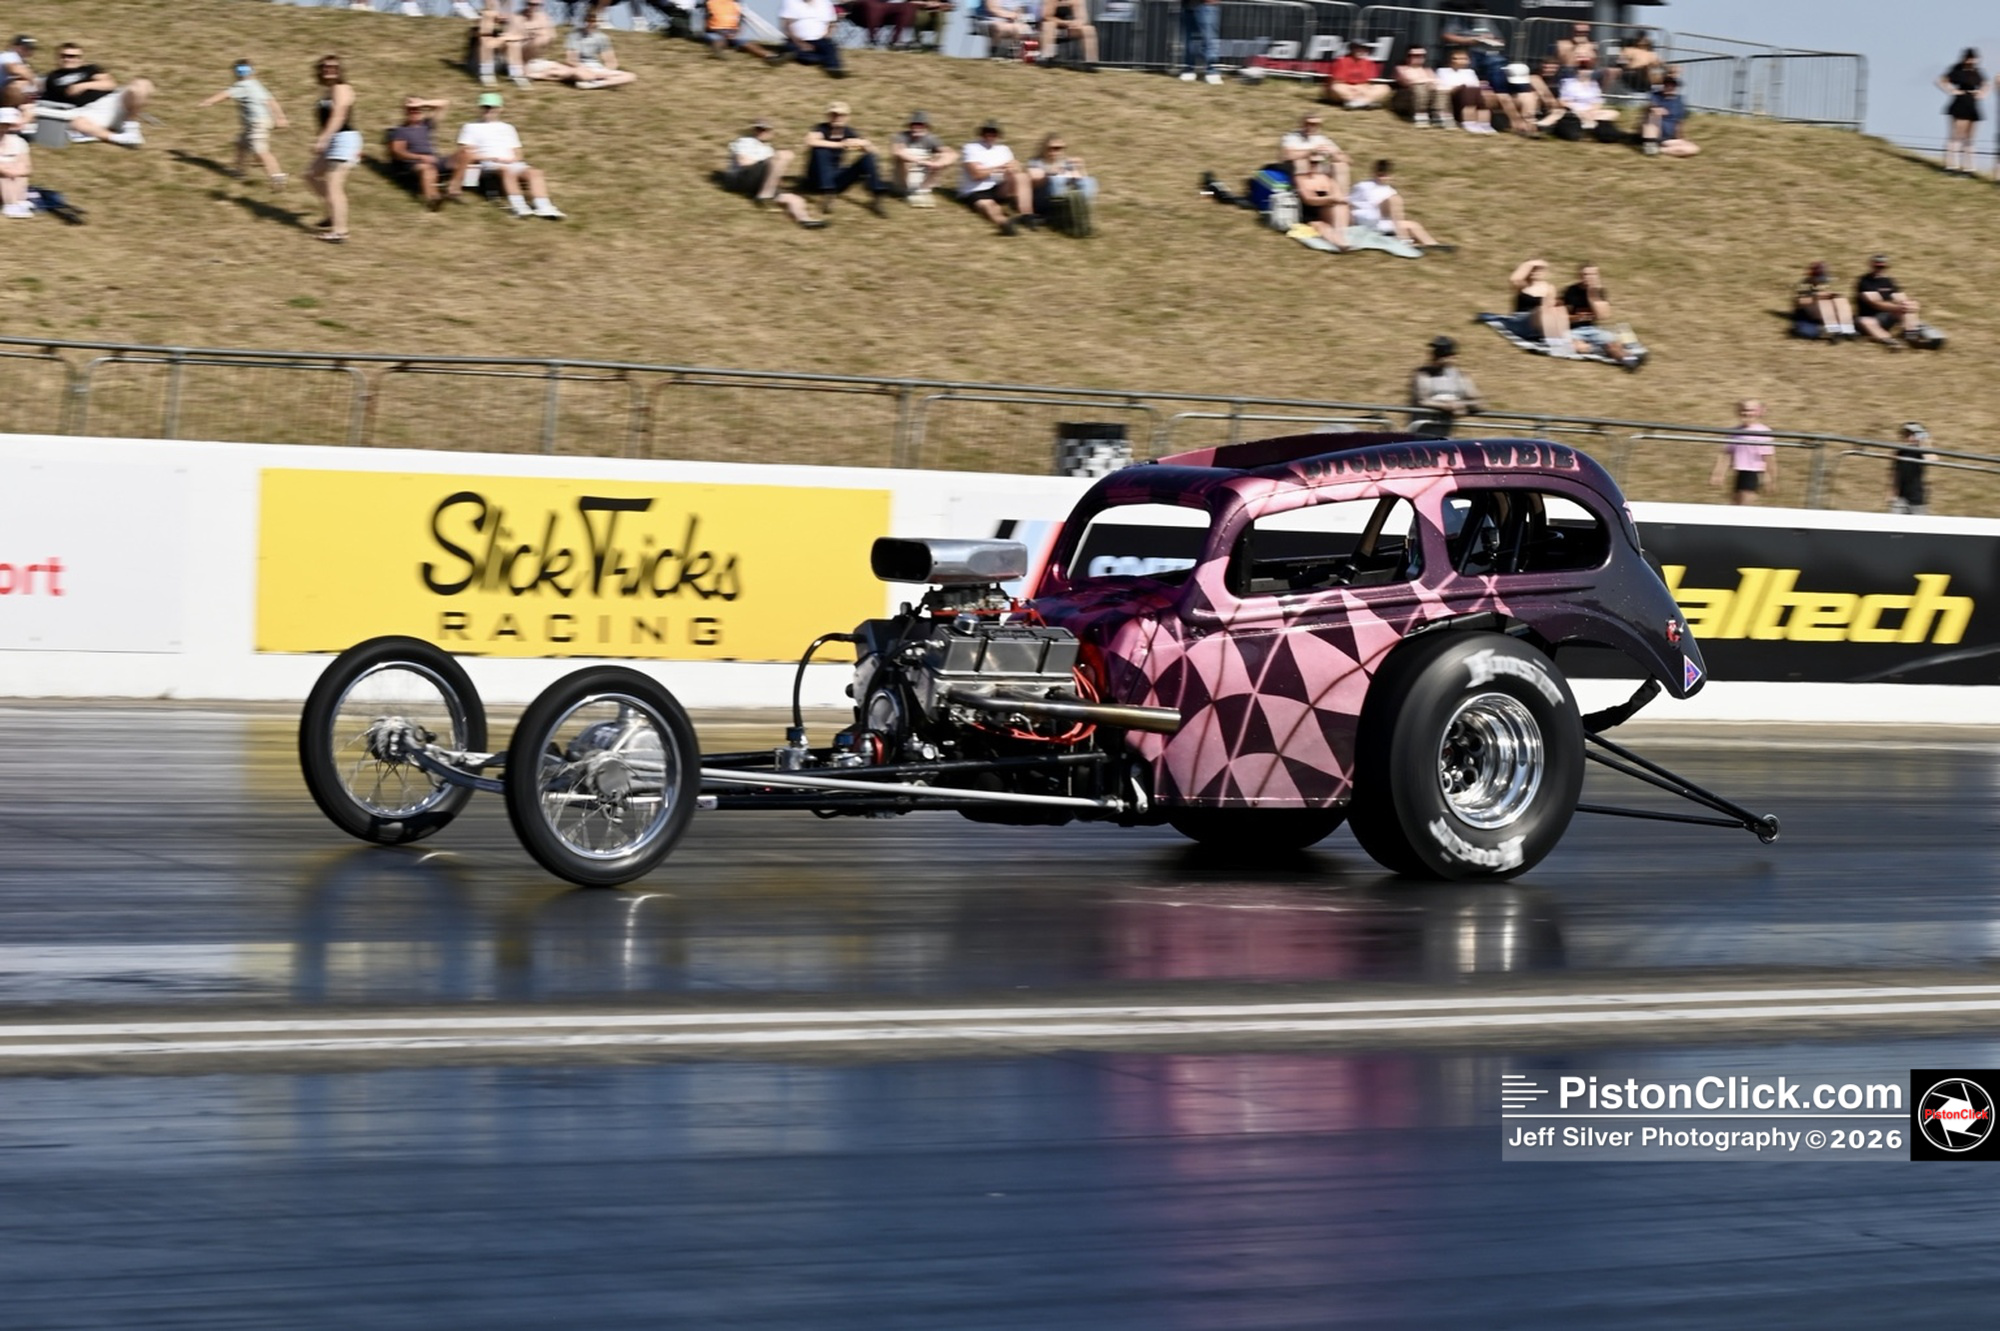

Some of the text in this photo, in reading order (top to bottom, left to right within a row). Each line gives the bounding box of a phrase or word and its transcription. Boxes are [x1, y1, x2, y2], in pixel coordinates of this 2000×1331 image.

[1305, 35, 1394, 61] Pd
[418, 491, 741, 600] Slick Tricks
[437, 611, 723, 646] RACING
[1661, 565, 1975, 644] altech
